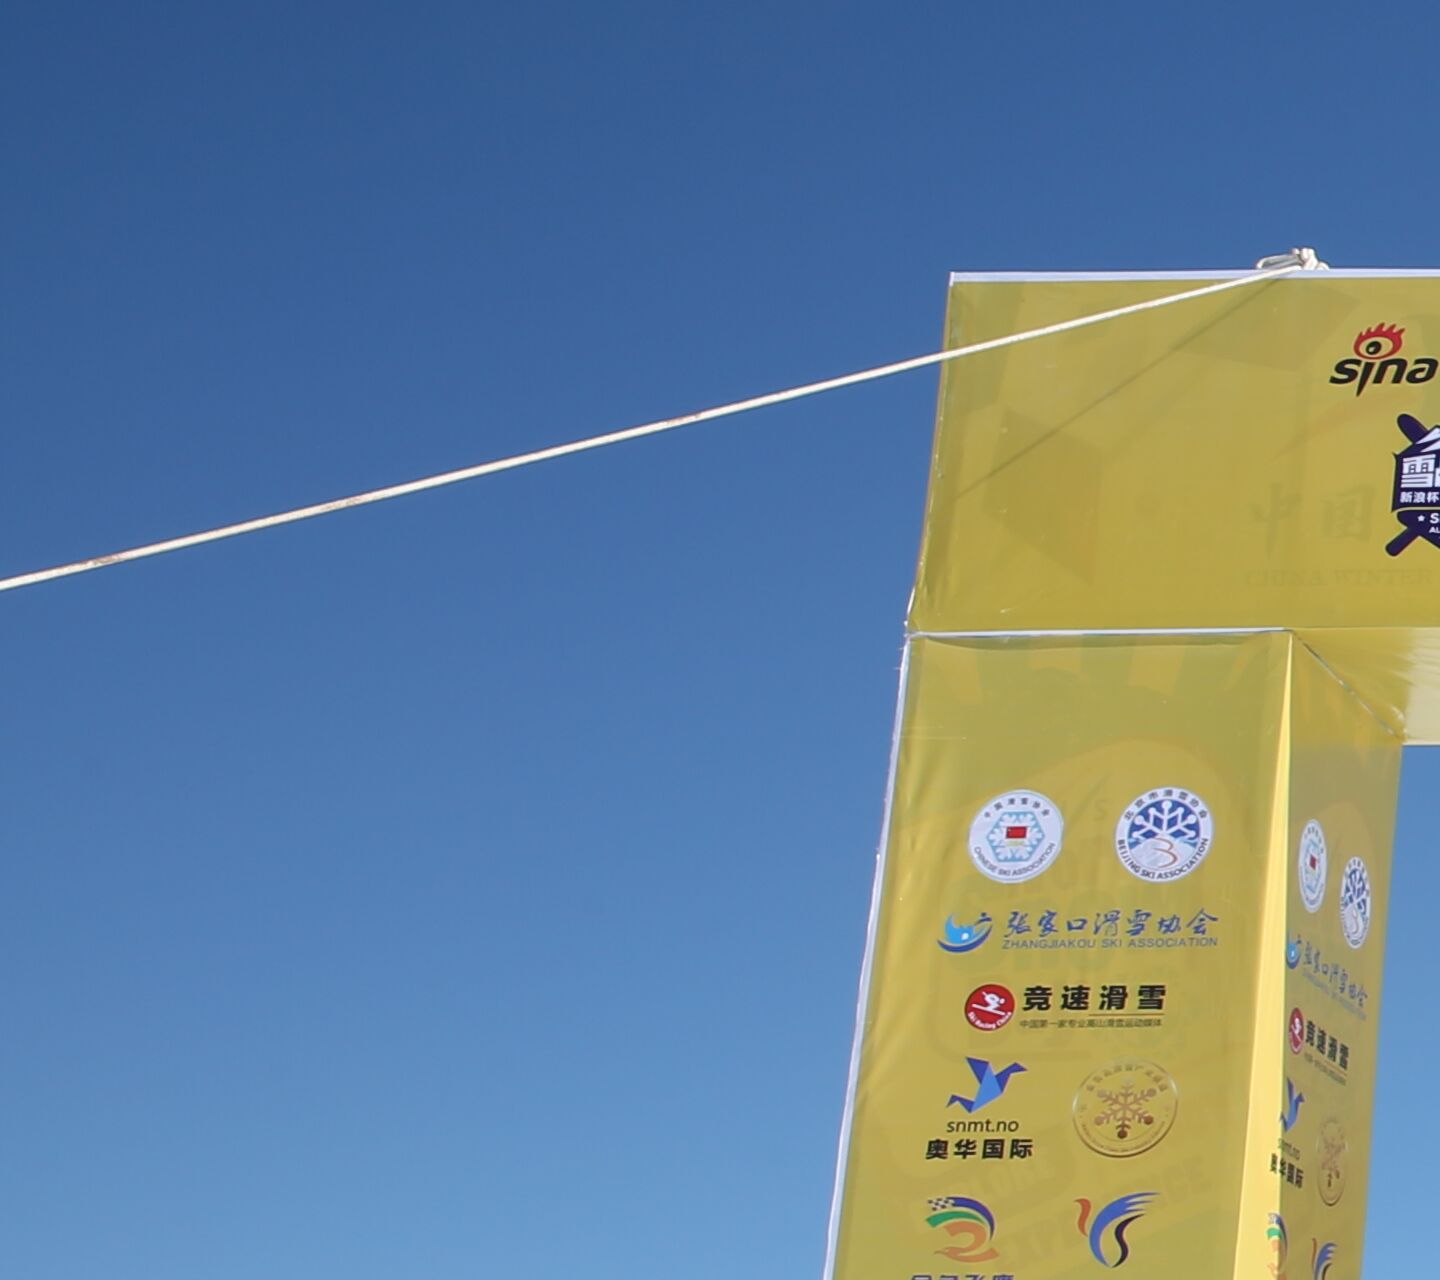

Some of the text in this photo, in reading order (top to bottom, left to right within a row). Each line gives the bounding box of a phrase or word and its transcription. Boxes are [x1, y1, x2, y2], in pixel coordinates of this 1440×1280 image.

[1329, 357, 1439, 397] sina
[1117, 838, 1140, 874] BEIJING
[1156, 836, 1210, 880] ASSOCIATION
[1004, 908, 1218, 938] 张家口滑雪协会
[1001, 936, 1218, 950] ZHANGJIAKOU SKI ASSOCIATION
[1022, 984, 1166, 1011] 竞速滑雪
[1305, 1020, 1349, 1071] 竞速滑雪
[946, 1118, 1019, 1133] snmt.no
[925, 1138, 1034, 1160] 奥华国际
